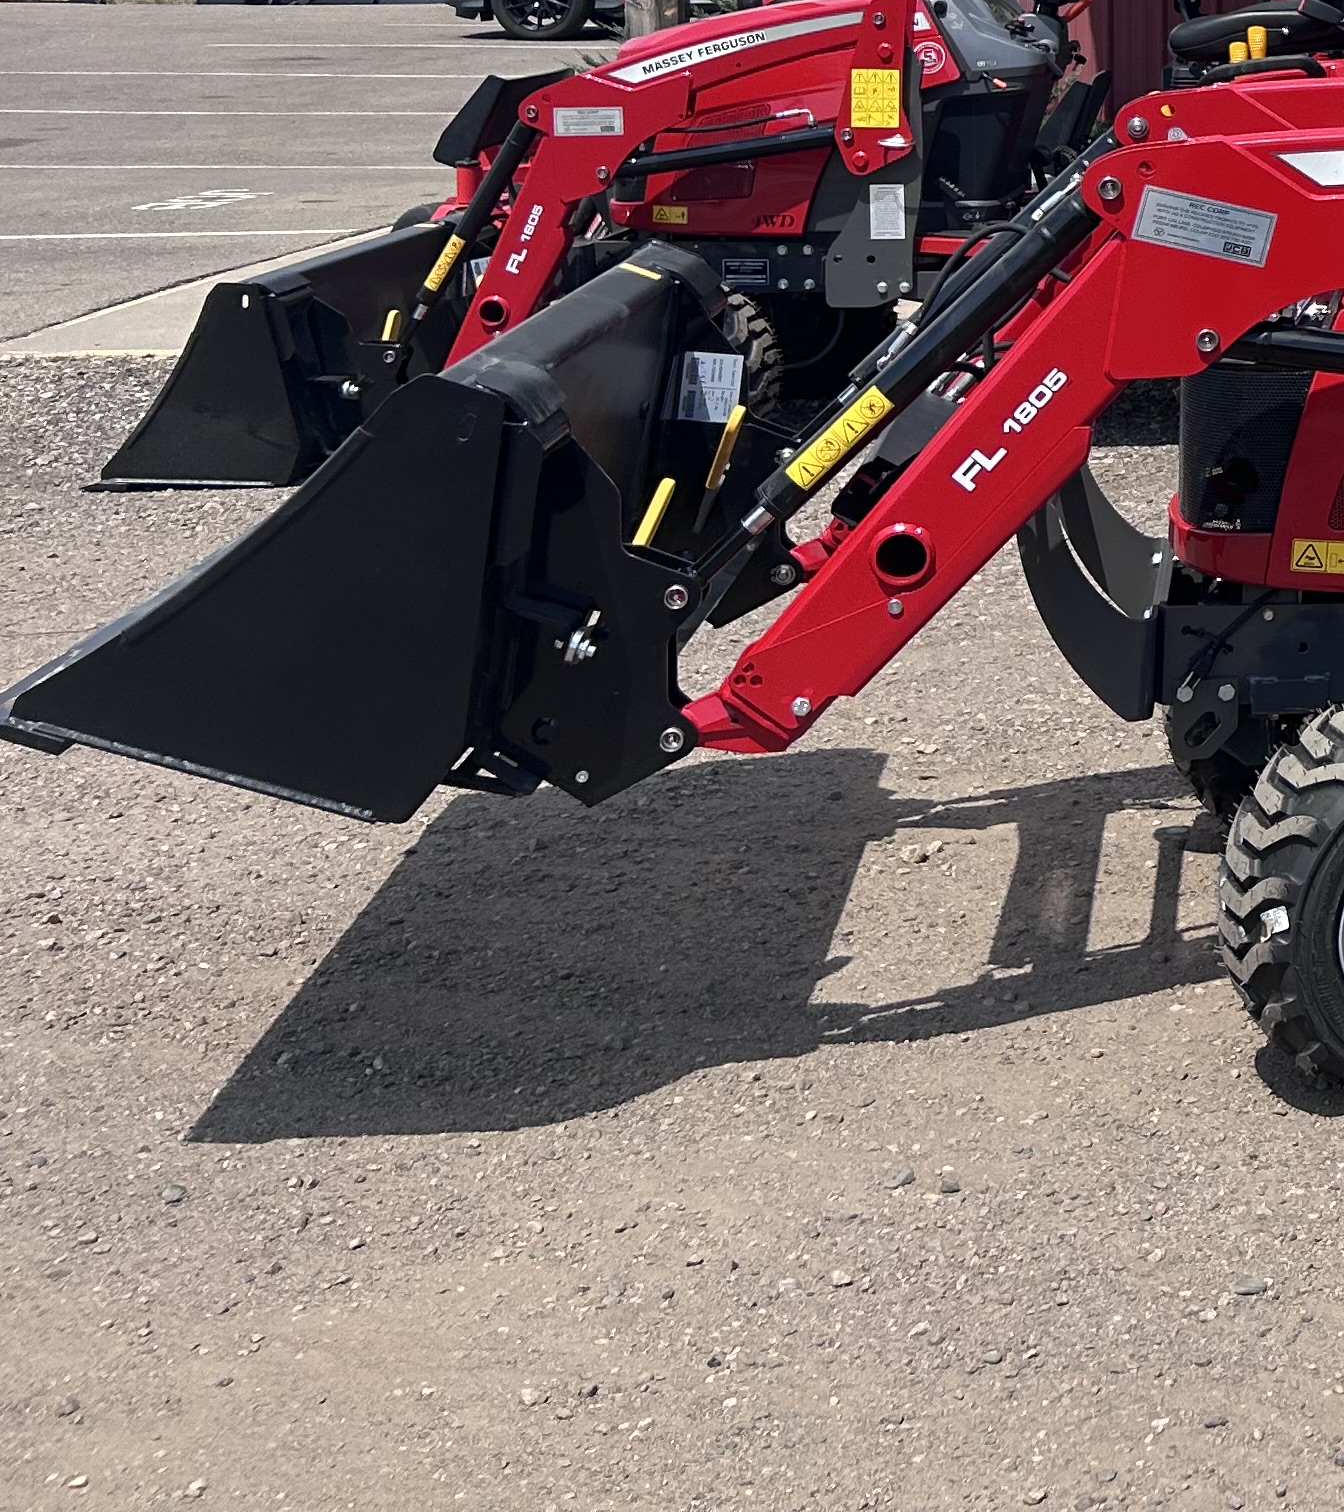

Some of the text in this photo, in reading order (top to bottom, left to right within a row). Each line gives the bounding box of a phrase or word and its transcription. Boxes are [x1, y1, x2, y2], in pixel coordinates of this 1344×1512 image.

[642, 32, 766, 75] MASSEY FERGUSON
[505, 203, 543, 275] FL 1805
[951, 367, 1068, 492] FL 1805
